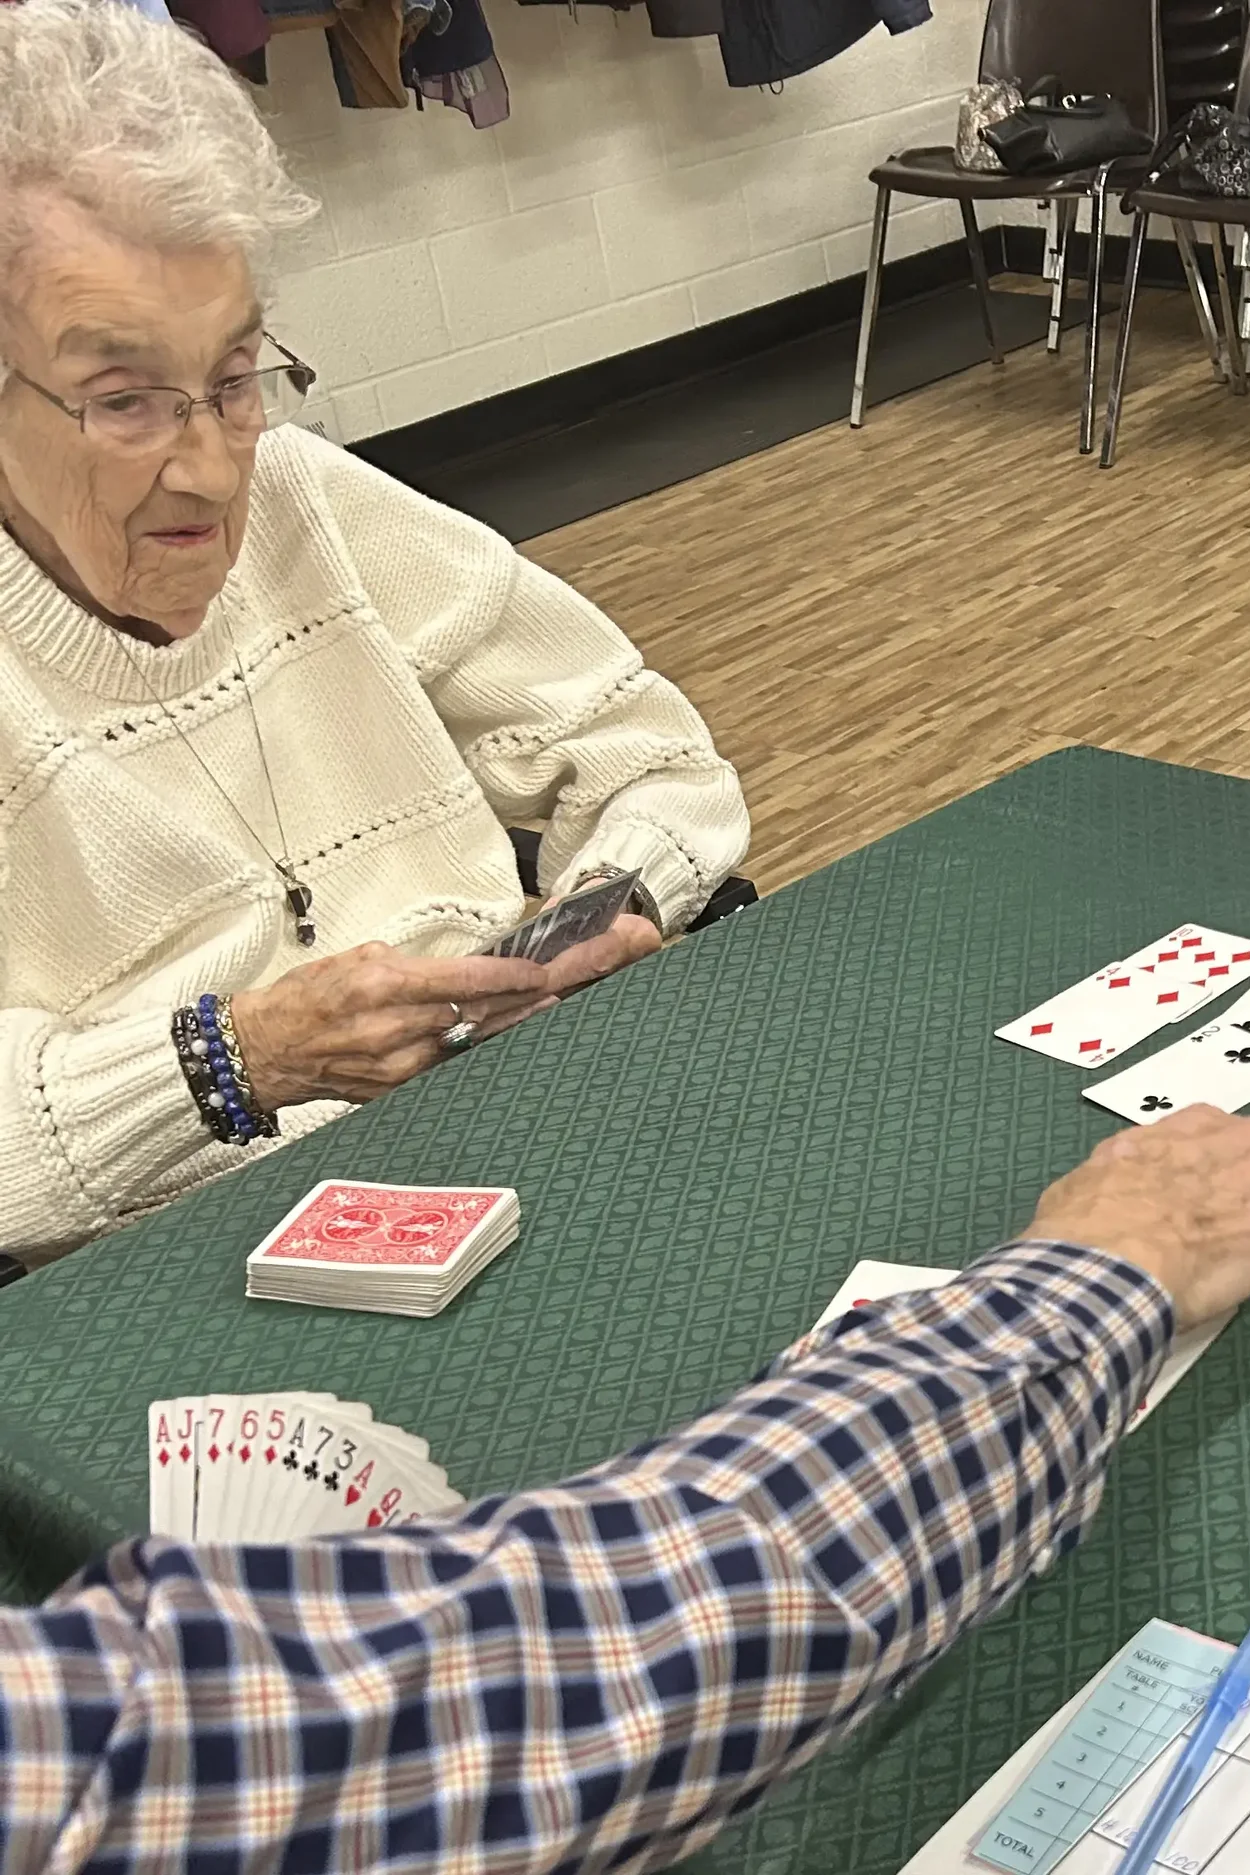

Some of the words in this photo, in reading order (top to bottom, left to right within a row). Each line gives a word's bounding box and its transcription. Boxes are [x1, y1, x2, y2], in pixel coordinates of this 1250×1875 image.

[1201, 1025, 1221, 1037] 2
[156, 1413, 172, 1443] A
[177, 1409, 194, 1440] J
[208, 1408, 225, 1438] 7
[240, 1410, 260, 1440] 6
[266, 1410, 286, 1441] 5
[289, 1417, 306, 1449] A
[314, 1425, 334, 1456] 7
[334, 1439, 357, 1471] 3
[354, 1460, 375, 1490] A
[380, 1488, 403, 1516] Q
[1132, 1651, 1171, 1671] NAME
[1126, 1669, 1161, 1690] TABLE
[1096, 1725, 1108, 1737] 2
[1076, 1752, 1088, 1764] 3
[1056, 1780, 1066, 1790] 4
[1034, 1807, 1046, 1818] 5
[993, 1831, 1035, 1859] TOTAL
